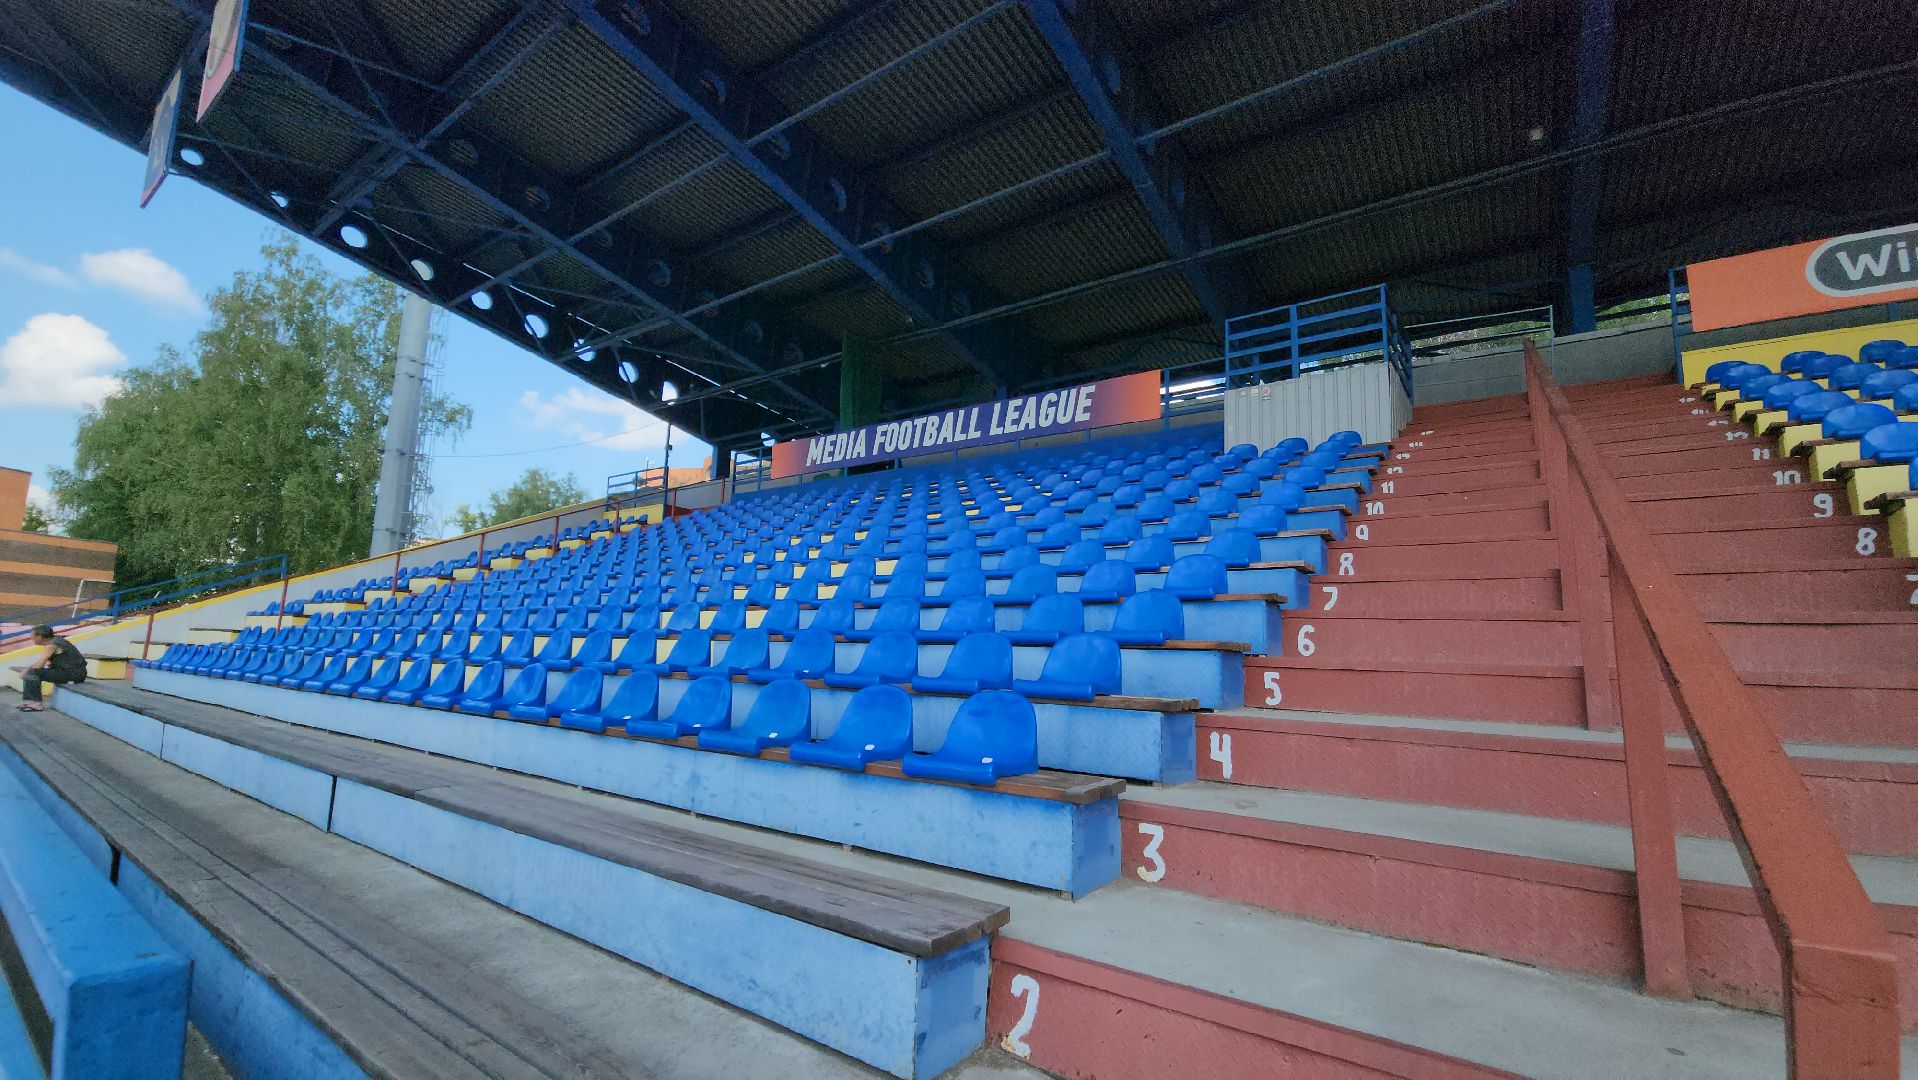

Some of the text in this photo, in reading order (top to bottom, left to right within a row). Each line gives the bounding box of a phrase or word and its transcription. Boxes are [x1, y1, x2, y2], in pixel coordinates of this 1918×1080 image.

[1836, 241, 1918, 281] Wi
[806, 385, 1096, 467] MEDIA FOOTBALL LEAGUE
[1813, 493, 1833, 518] 9
[1856, 527, 1877, 556] 8
[1338, 552, 1355, 575] 8
[1322, 586, 1338, 611] 7
[1297, 624, 1315, 657] 6
[1264, 671, 1282, 706] 5
[1209, 731, 1232, 779] 4
[1136, 822, 1166, 883] 3
[1001, 973, 1040, 1060] 2
